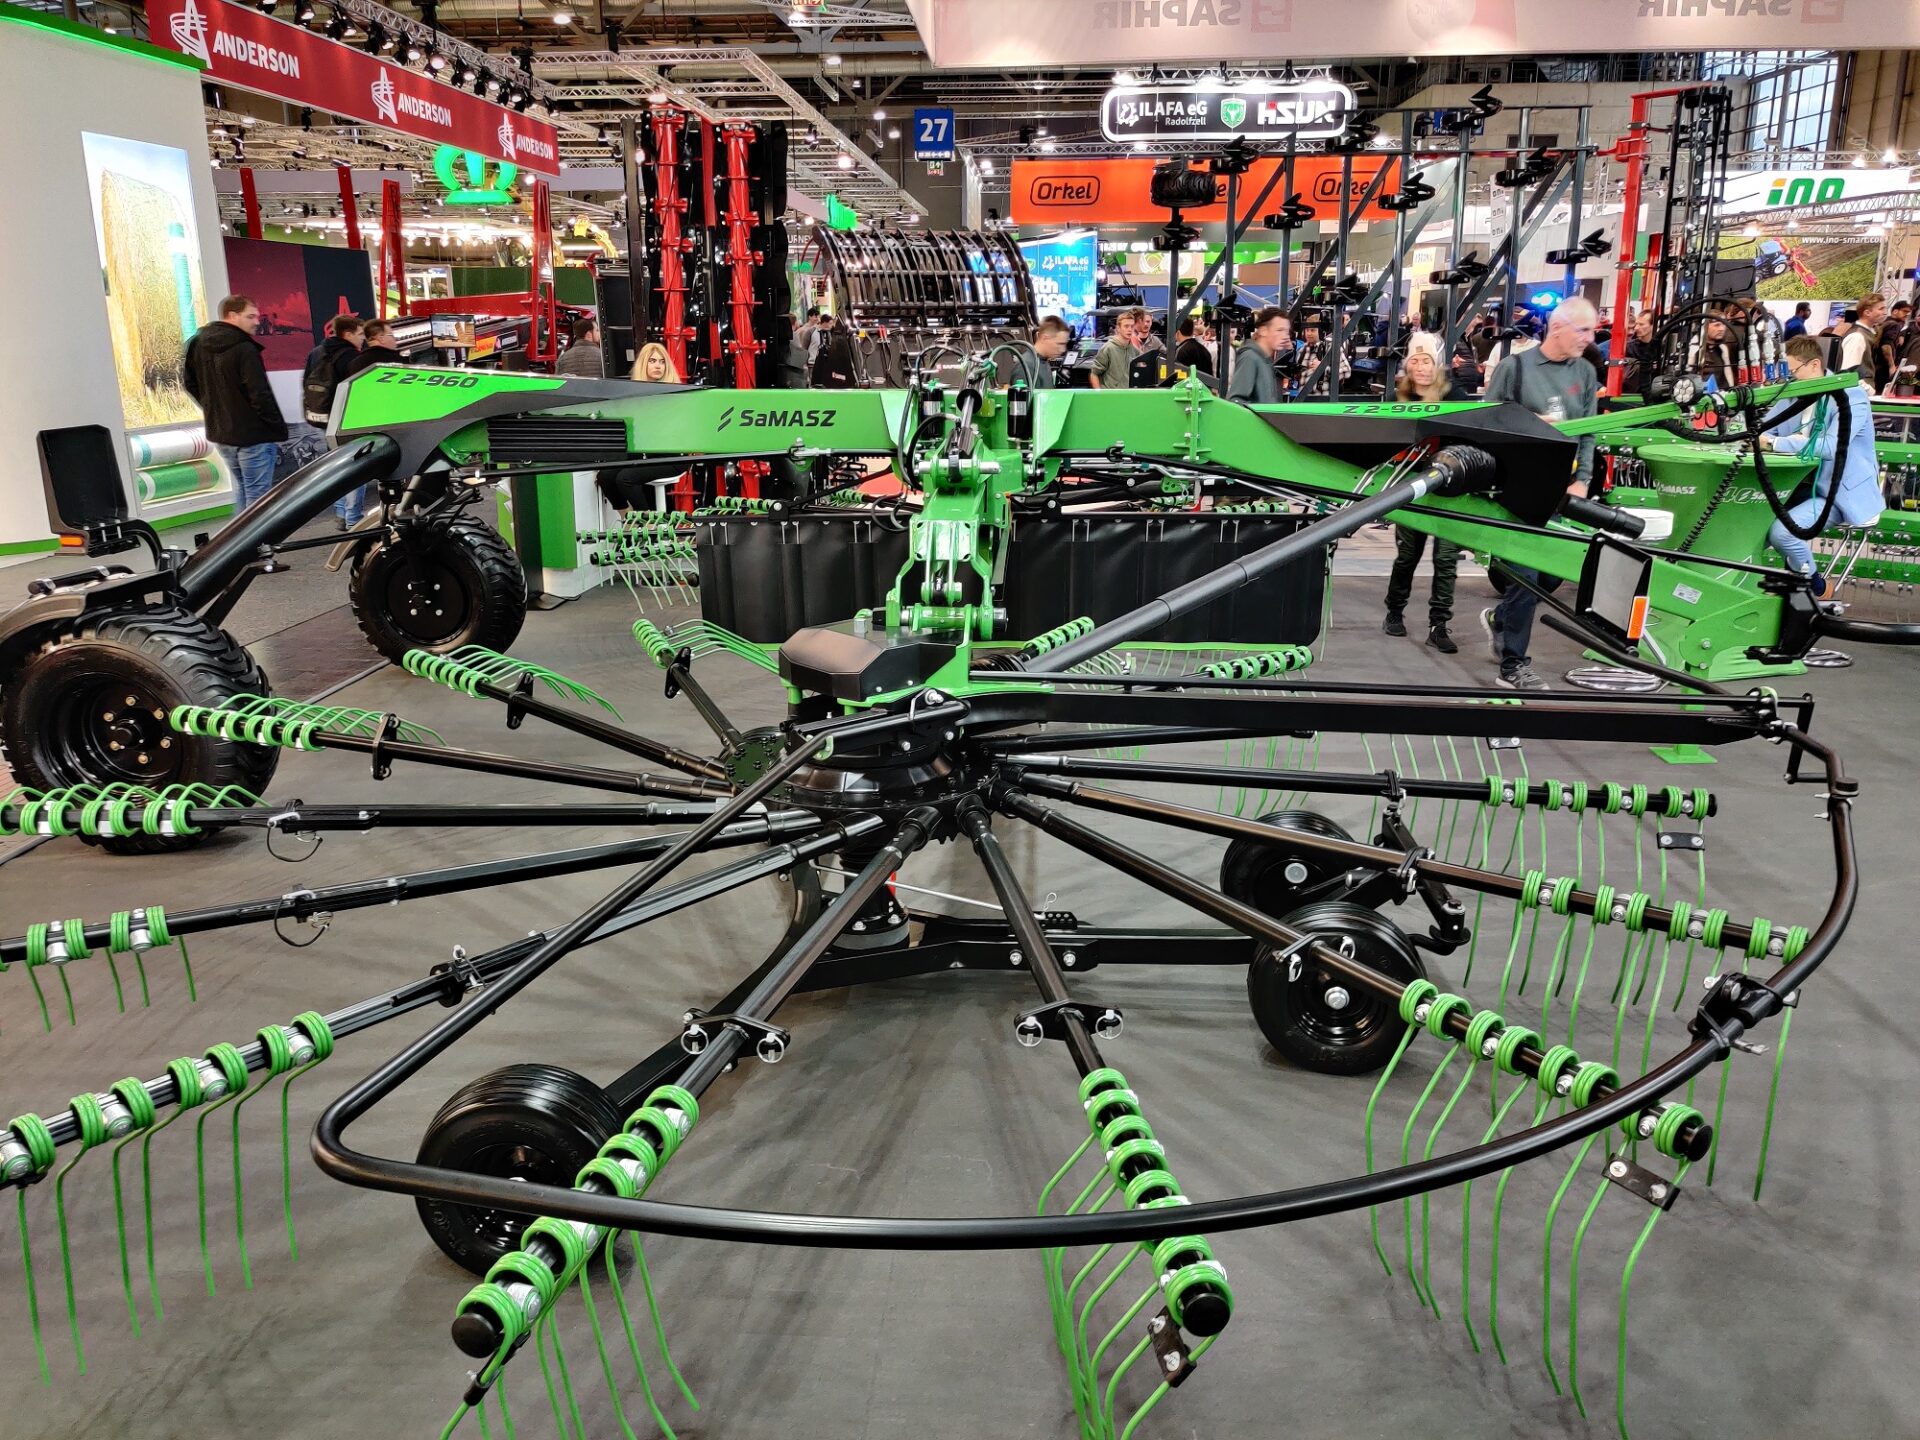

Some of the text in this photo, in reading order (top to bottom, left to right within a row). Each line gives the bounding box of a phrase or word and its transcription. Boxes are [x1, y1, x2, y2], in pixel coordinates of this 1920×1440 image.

[213, 31, 300, 79] ANDERSON
[398, 93, 452, 127] ANDERSON
[1139, 101, 1208, 117] ILAFA eG
[920, 118, 949, 142] 27
[1165, 116, 1207, 126] Radolfzell
[515, 134, 554, 160] ANDERSON
[1037, 182, 1093, 200] Orkel
[1766, 178, 1845, 205] ino
[1802, 236, 1883, 244] www.ino-smart.co
[376, 371, 479, 389] Z 2-960
[739, 409, 837, 427] SaMASZ
[1343, 404, 1441, 414] Z 2-960
